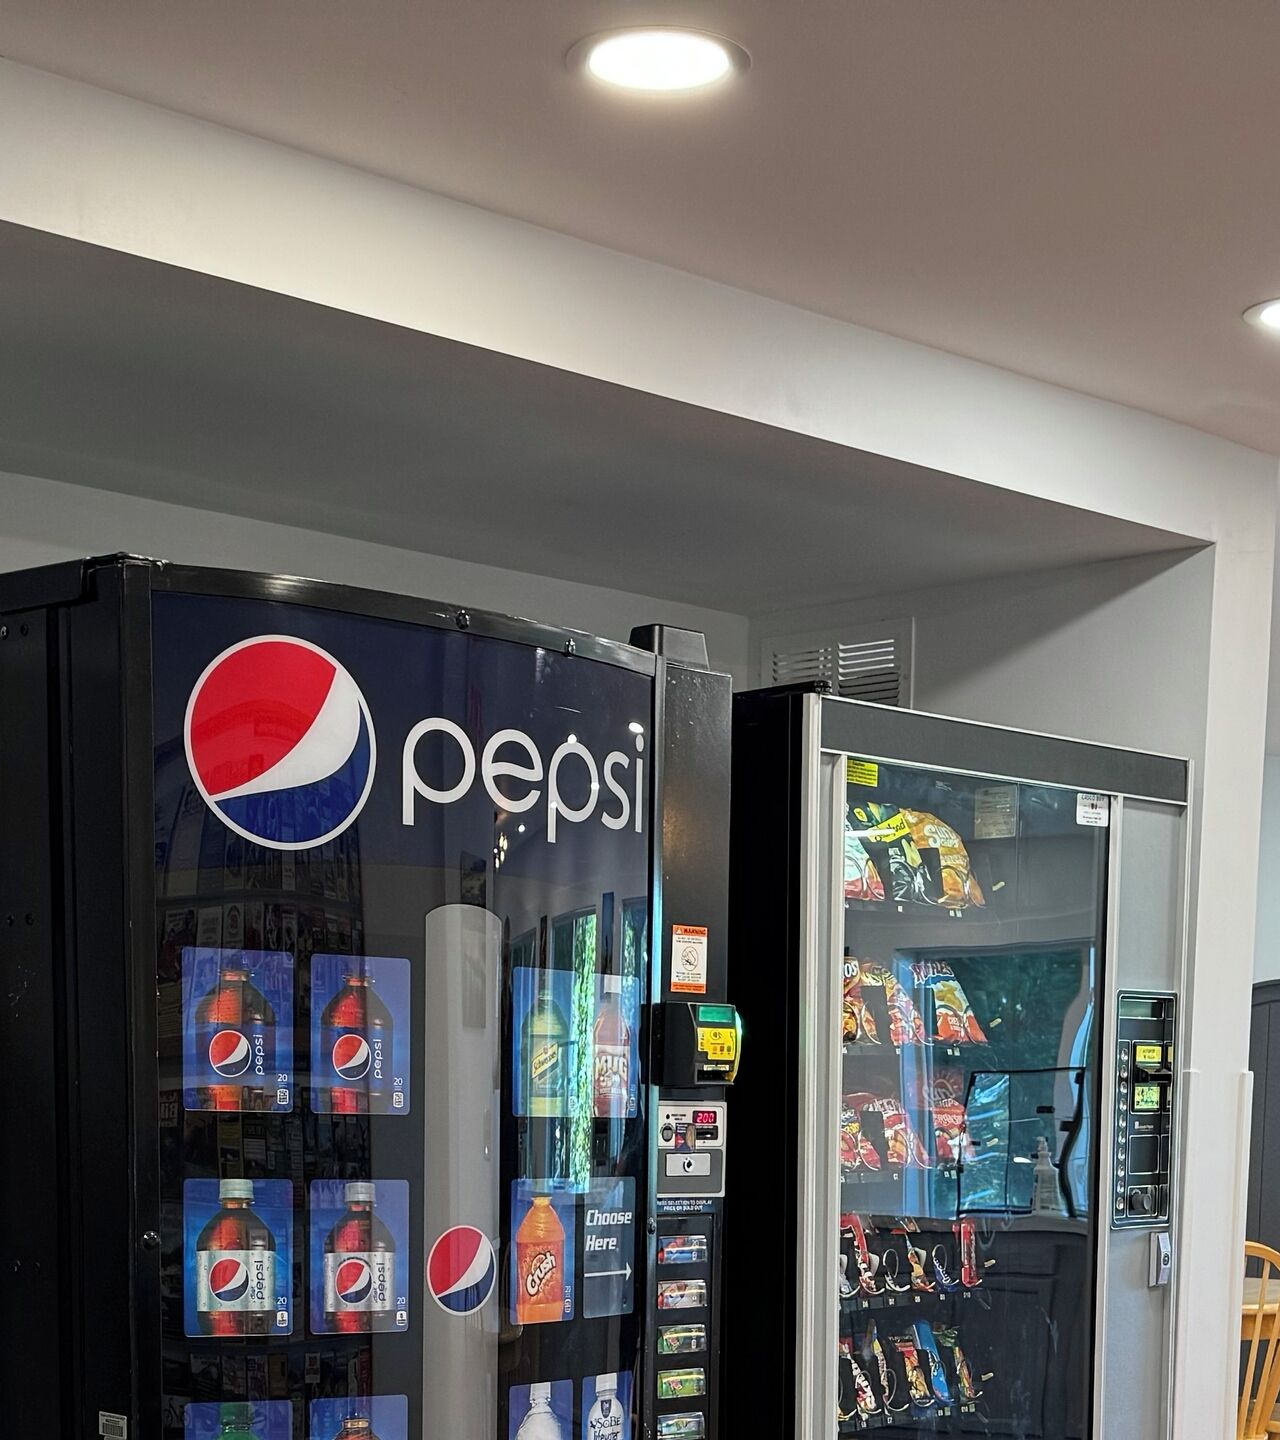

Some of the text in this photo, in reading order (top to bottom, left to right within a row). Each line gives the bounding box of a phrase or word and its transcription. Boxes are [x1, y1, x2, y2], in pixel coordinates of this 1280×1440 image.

[403, 716, 644, 844] pepsi
[253, 1034, 265, 1076] pepsi
[373, 1038, 384, 1079] pepsi
[277, 1073, 288, 1082] 20
[393, 1077, 403, 1086] 20
[585, 1209, 632, 1226] Choose
[254, 1260, 266, 1300] pepsi
[376, 1262, 387, 1302] pepsi
[525, 1250, 557, 1297] Crush
[276, 1296, 288, 1305] 20
